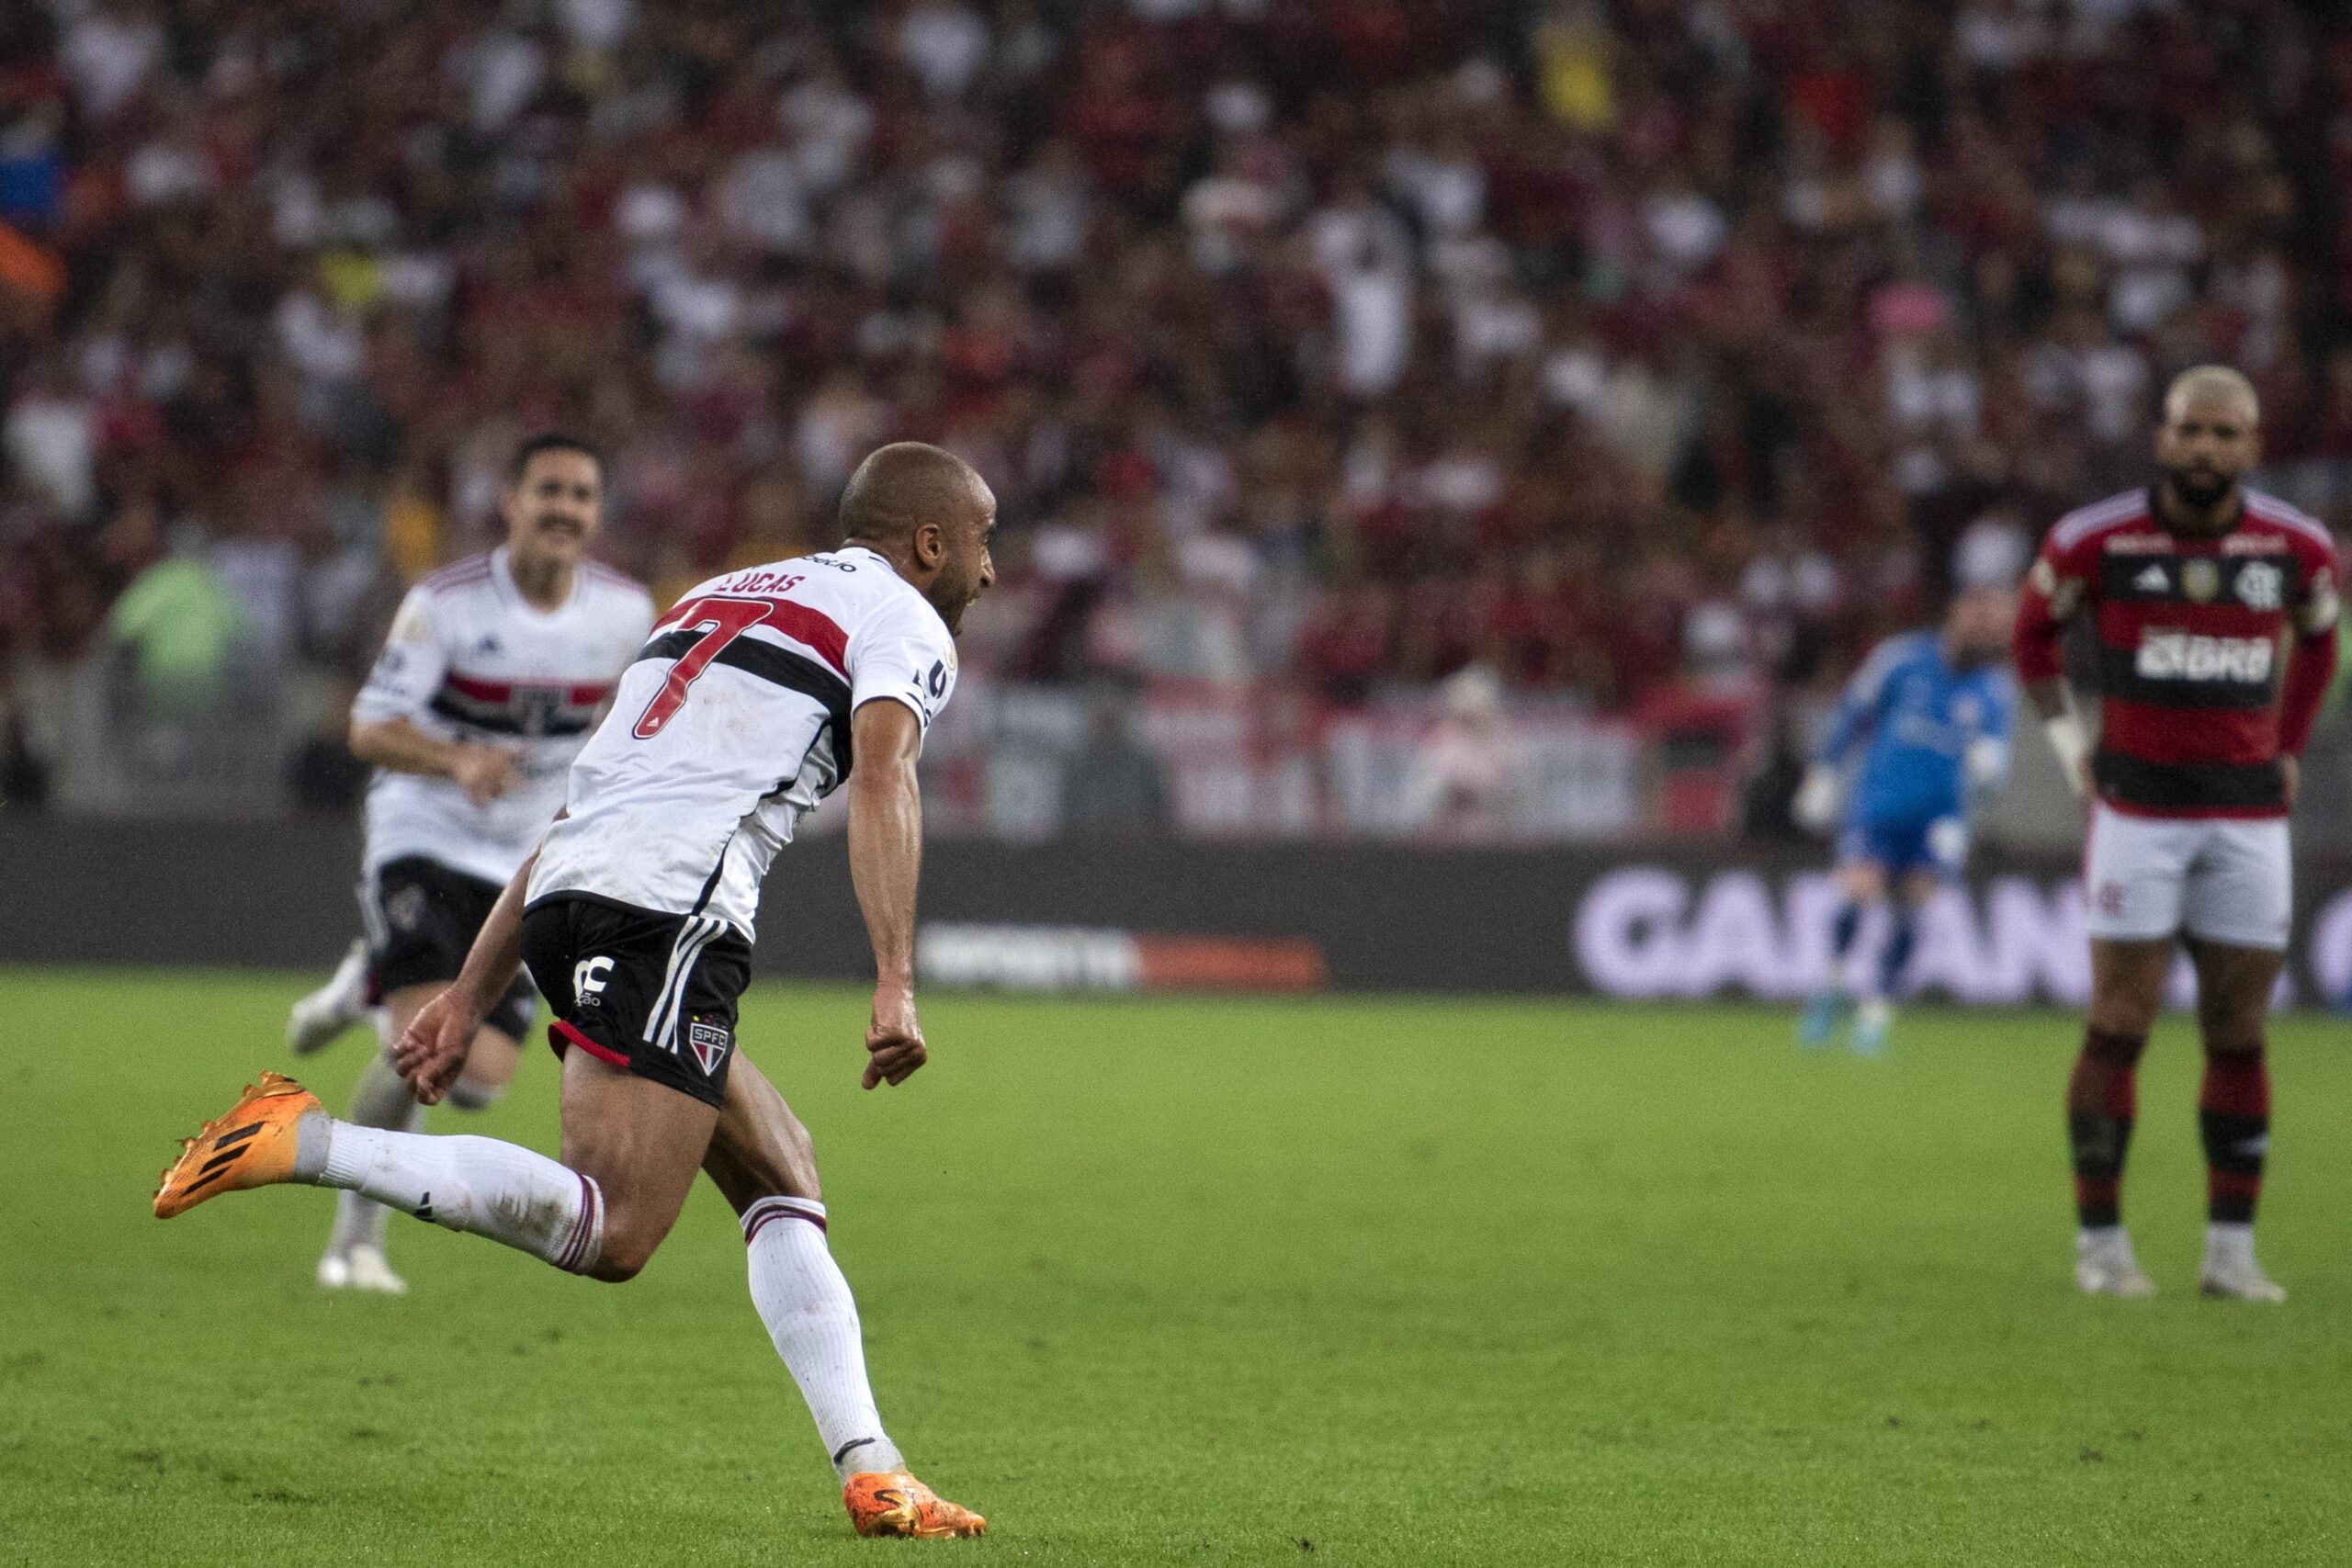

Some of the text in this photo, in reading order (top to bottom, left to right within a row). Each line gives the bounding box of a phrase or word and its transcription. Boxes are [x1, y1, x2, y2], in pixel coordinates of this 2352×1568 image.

[713, 573, 805, 592] LUCAS
[633, 595, 774, 739] 7
[695, 1028, 725, 1046] SPFC
